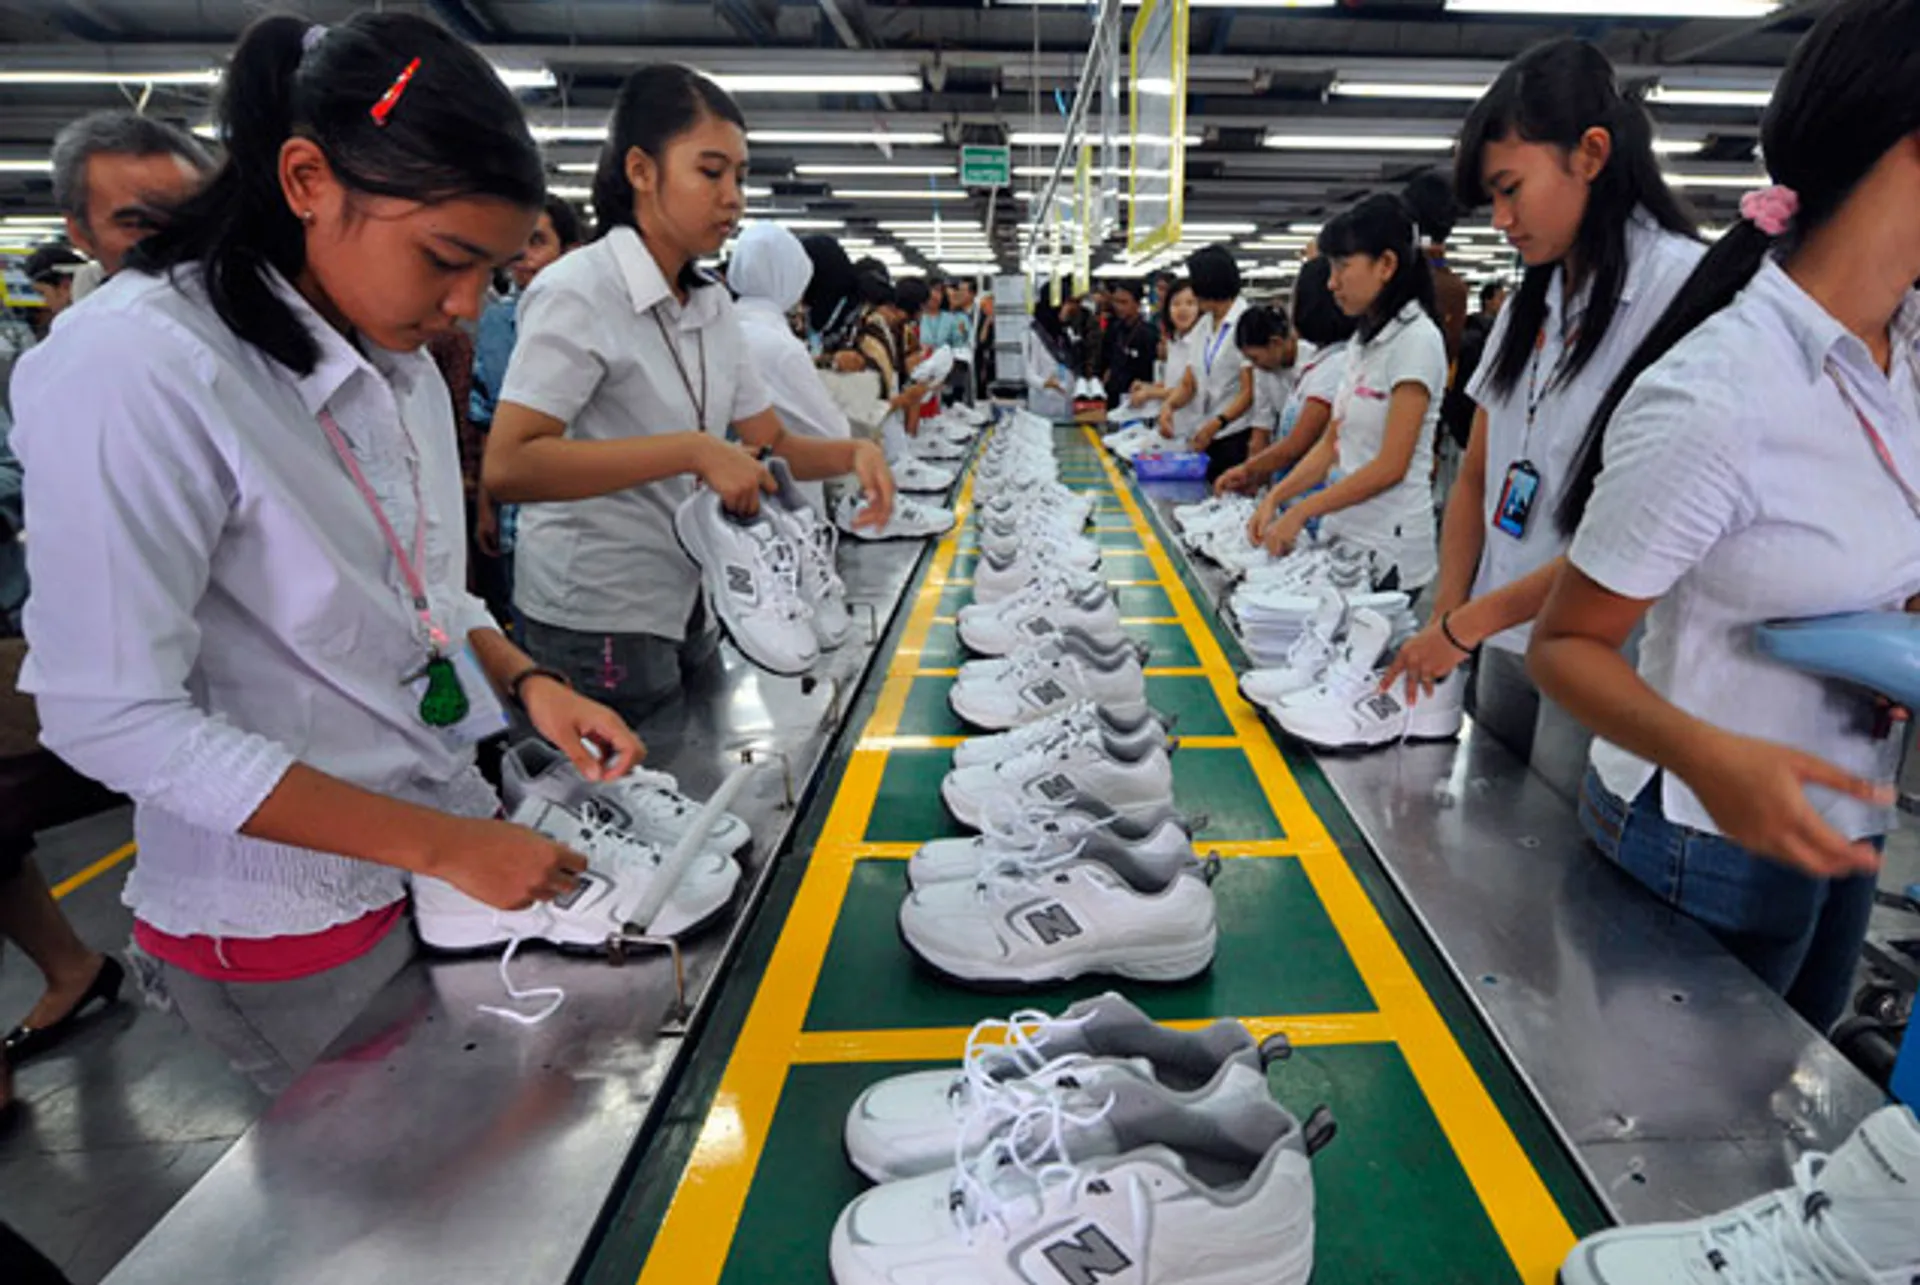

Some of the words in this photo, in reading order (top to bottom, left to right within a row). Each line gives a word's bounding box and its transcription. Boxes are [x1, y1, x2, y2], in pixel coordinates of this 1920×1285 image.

[725, 565, 755, 597] N
[1367, 693, 1401, 720] N
[1037, 774, 1075, 801] N
[1024, 904, 1082, 945] N
[1042, 1223, 1133, 1285] N
